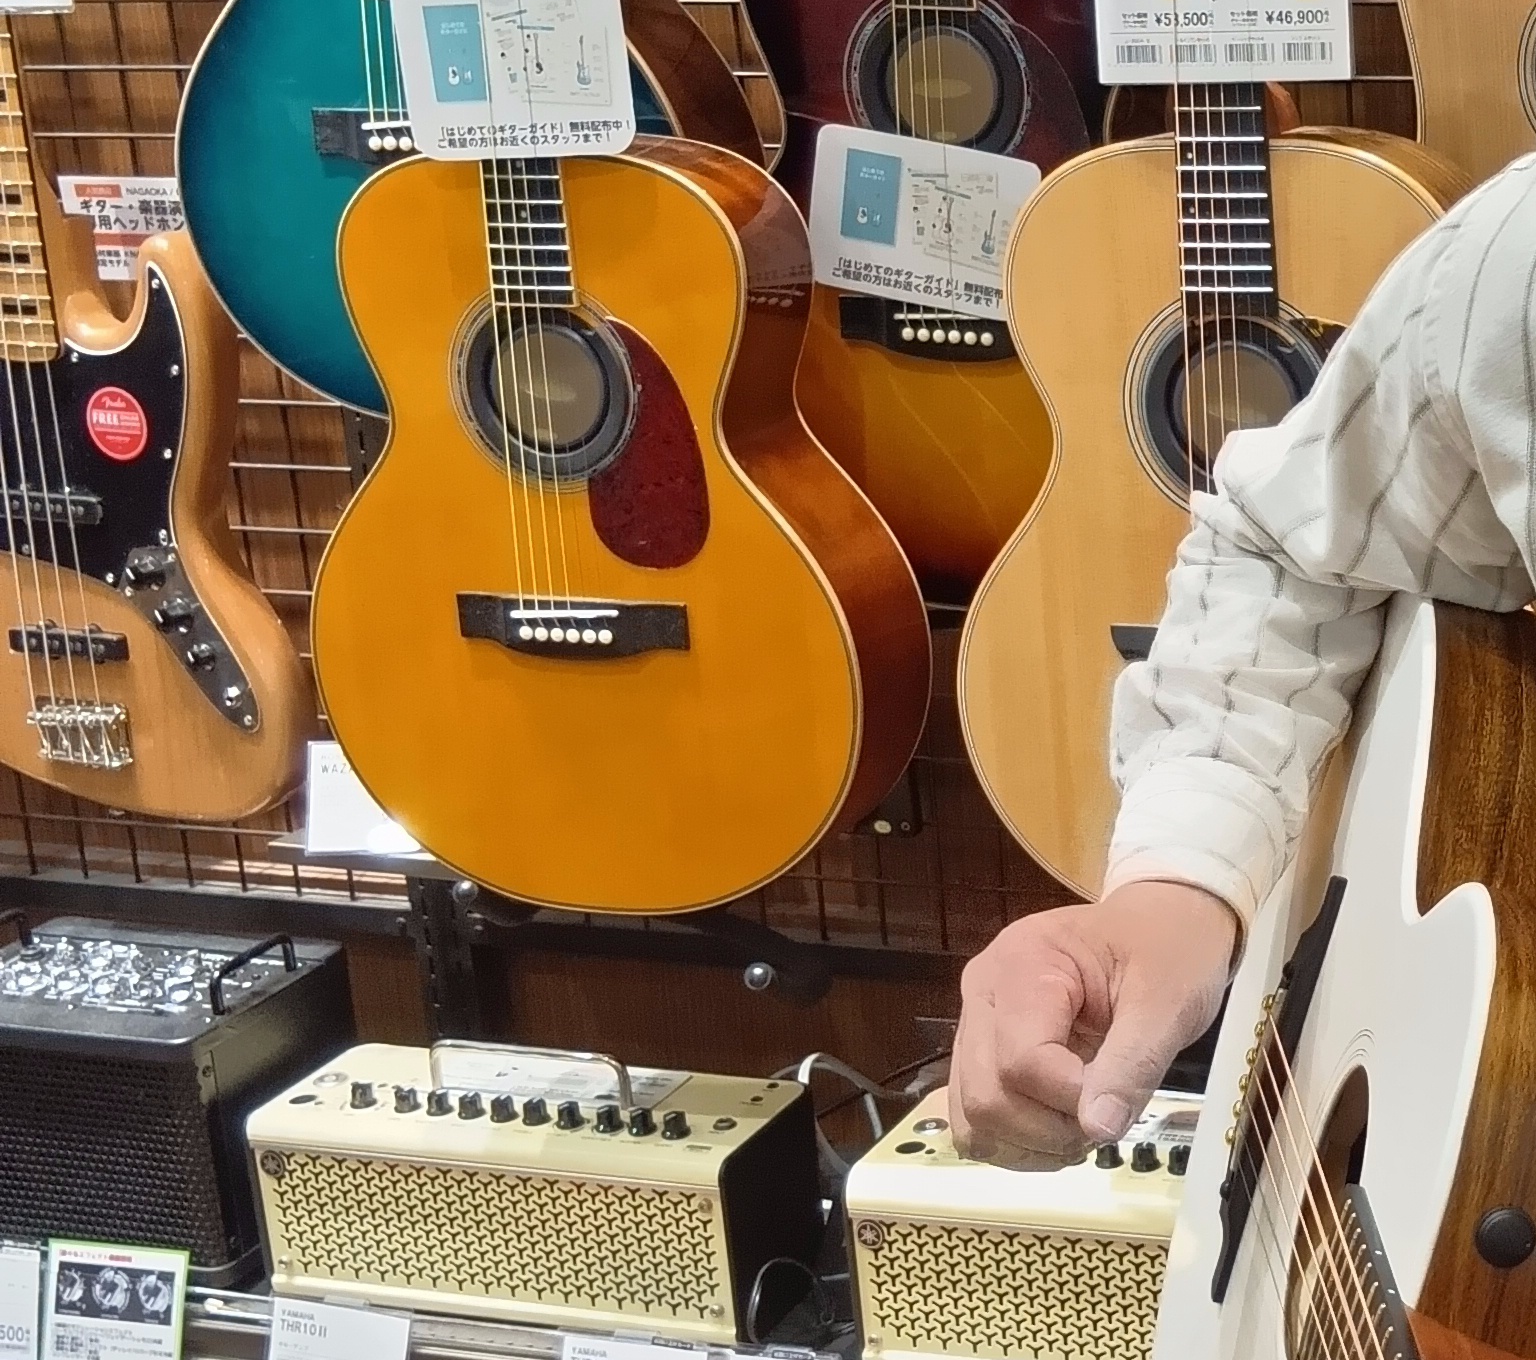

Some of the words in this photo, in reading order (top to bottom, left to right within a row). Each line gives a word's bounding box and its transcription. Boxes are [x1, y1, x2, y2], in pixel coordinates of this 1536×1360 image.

[1265, 10, 1324, 26] ¥46,900
[80, 199, 182, 216] ギター・楽器演
[838, 255, 1004, 299] 「はじめてのギターガイド」無料配布
[93, 411, 119, 425] FREE
[321, 763, 354, 774] WAZ
[280, 1309, 315, 1321] YAMAHA
[572, 1347, 607, 1358] YAMAHA
